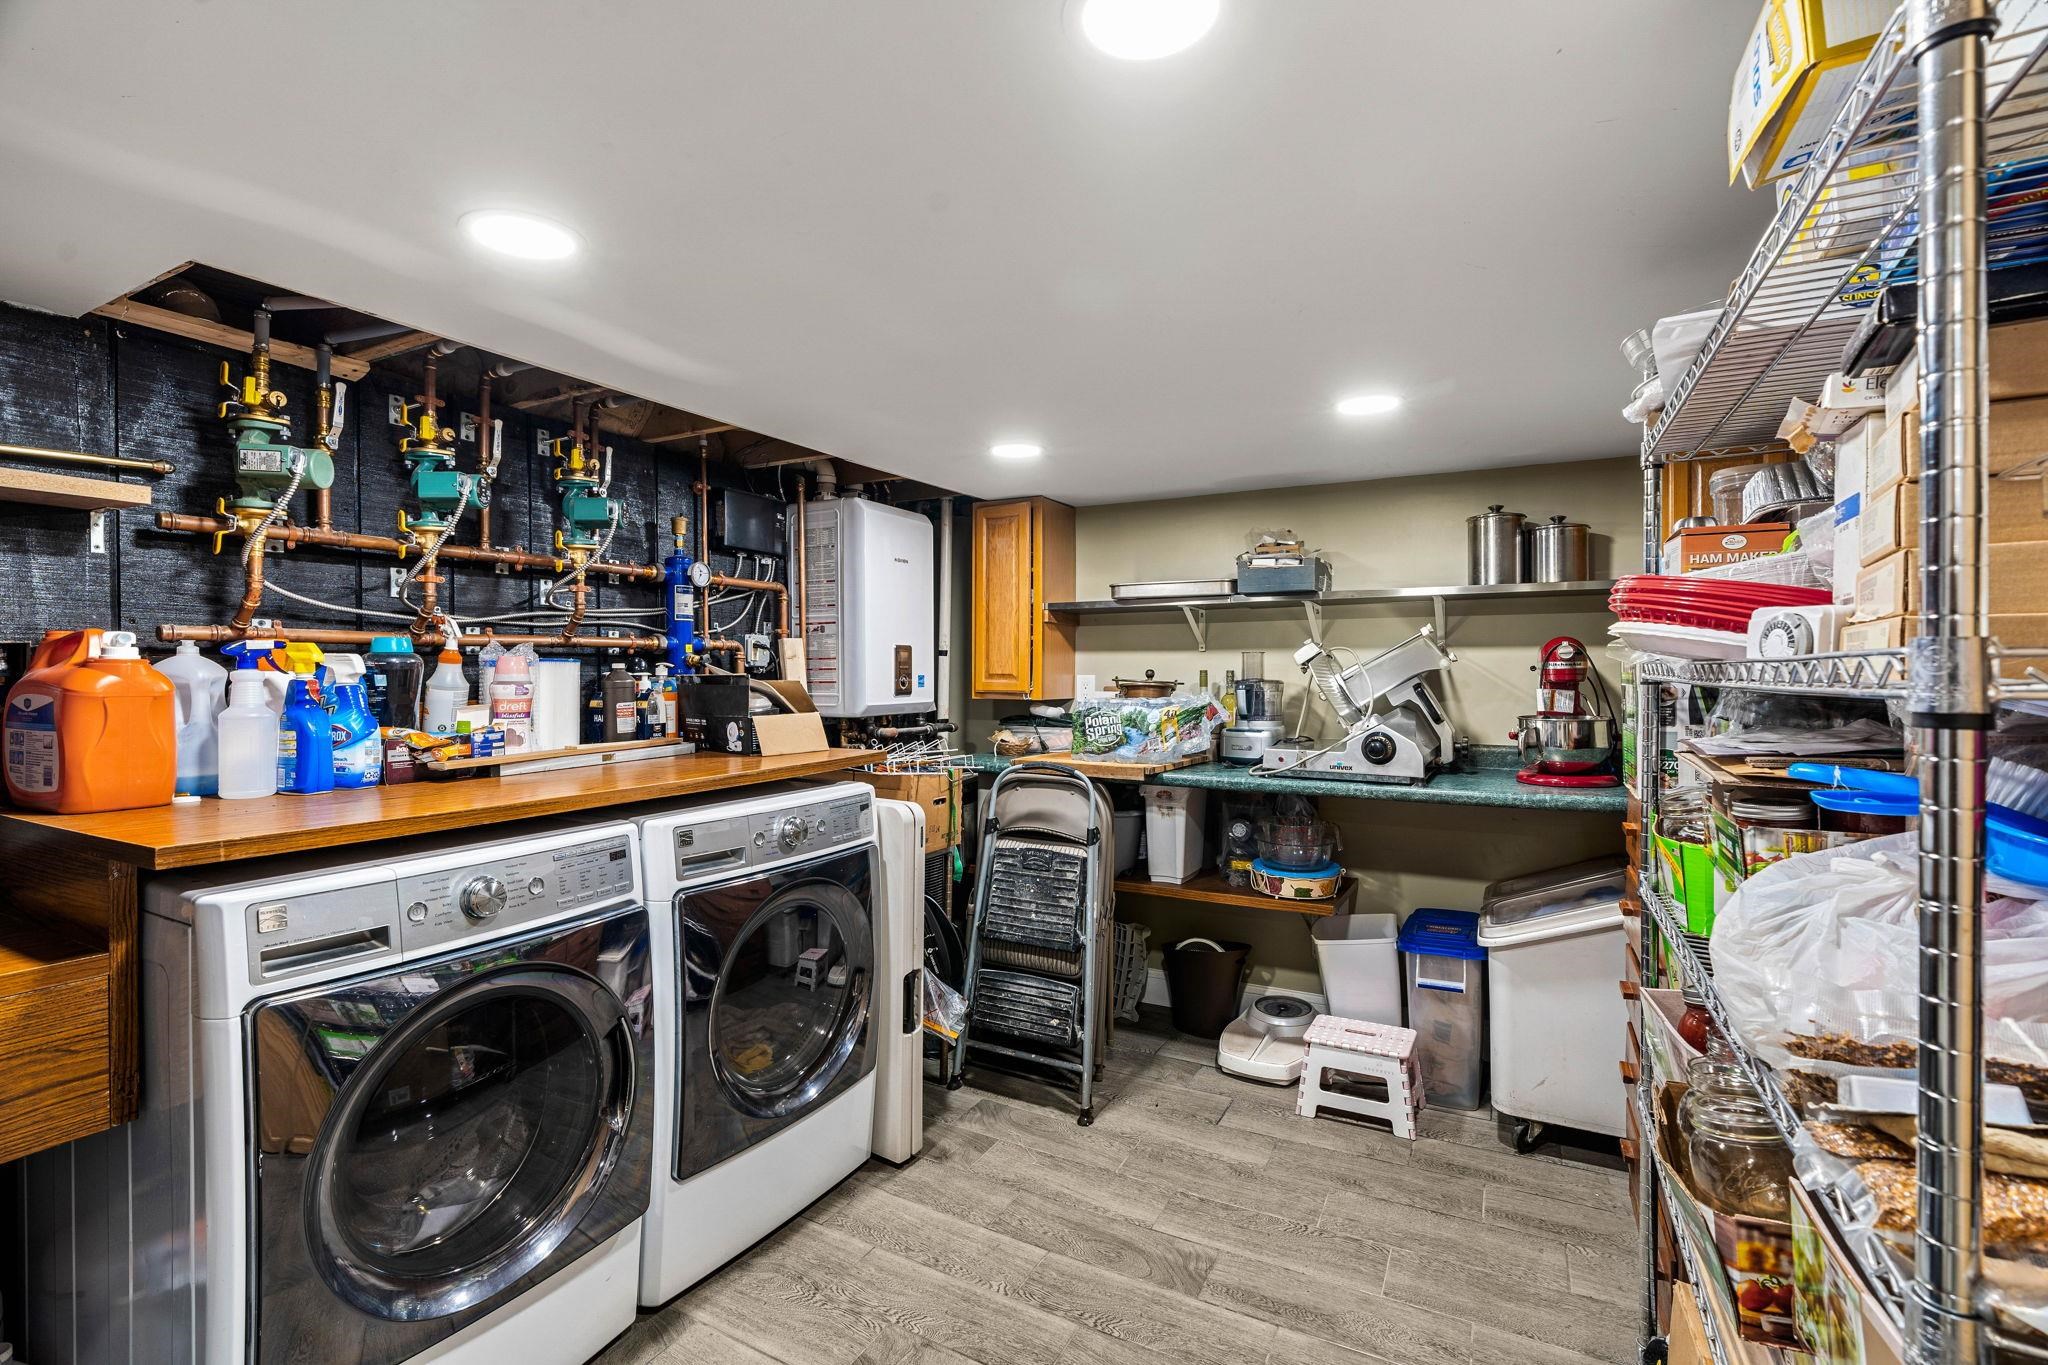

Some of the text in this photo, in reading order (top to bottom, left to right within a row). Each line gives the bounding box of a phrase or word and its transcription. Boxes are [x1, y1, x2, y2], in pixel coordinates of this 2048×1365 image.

[1689, 553, 1722, 564] HAM
[499, 700, 528, 711] dreft
[1085, 714, 1121, 729] Poland
[331, 731, 347, 741] ROX
[1086, 723, 1122, 741] Spring
